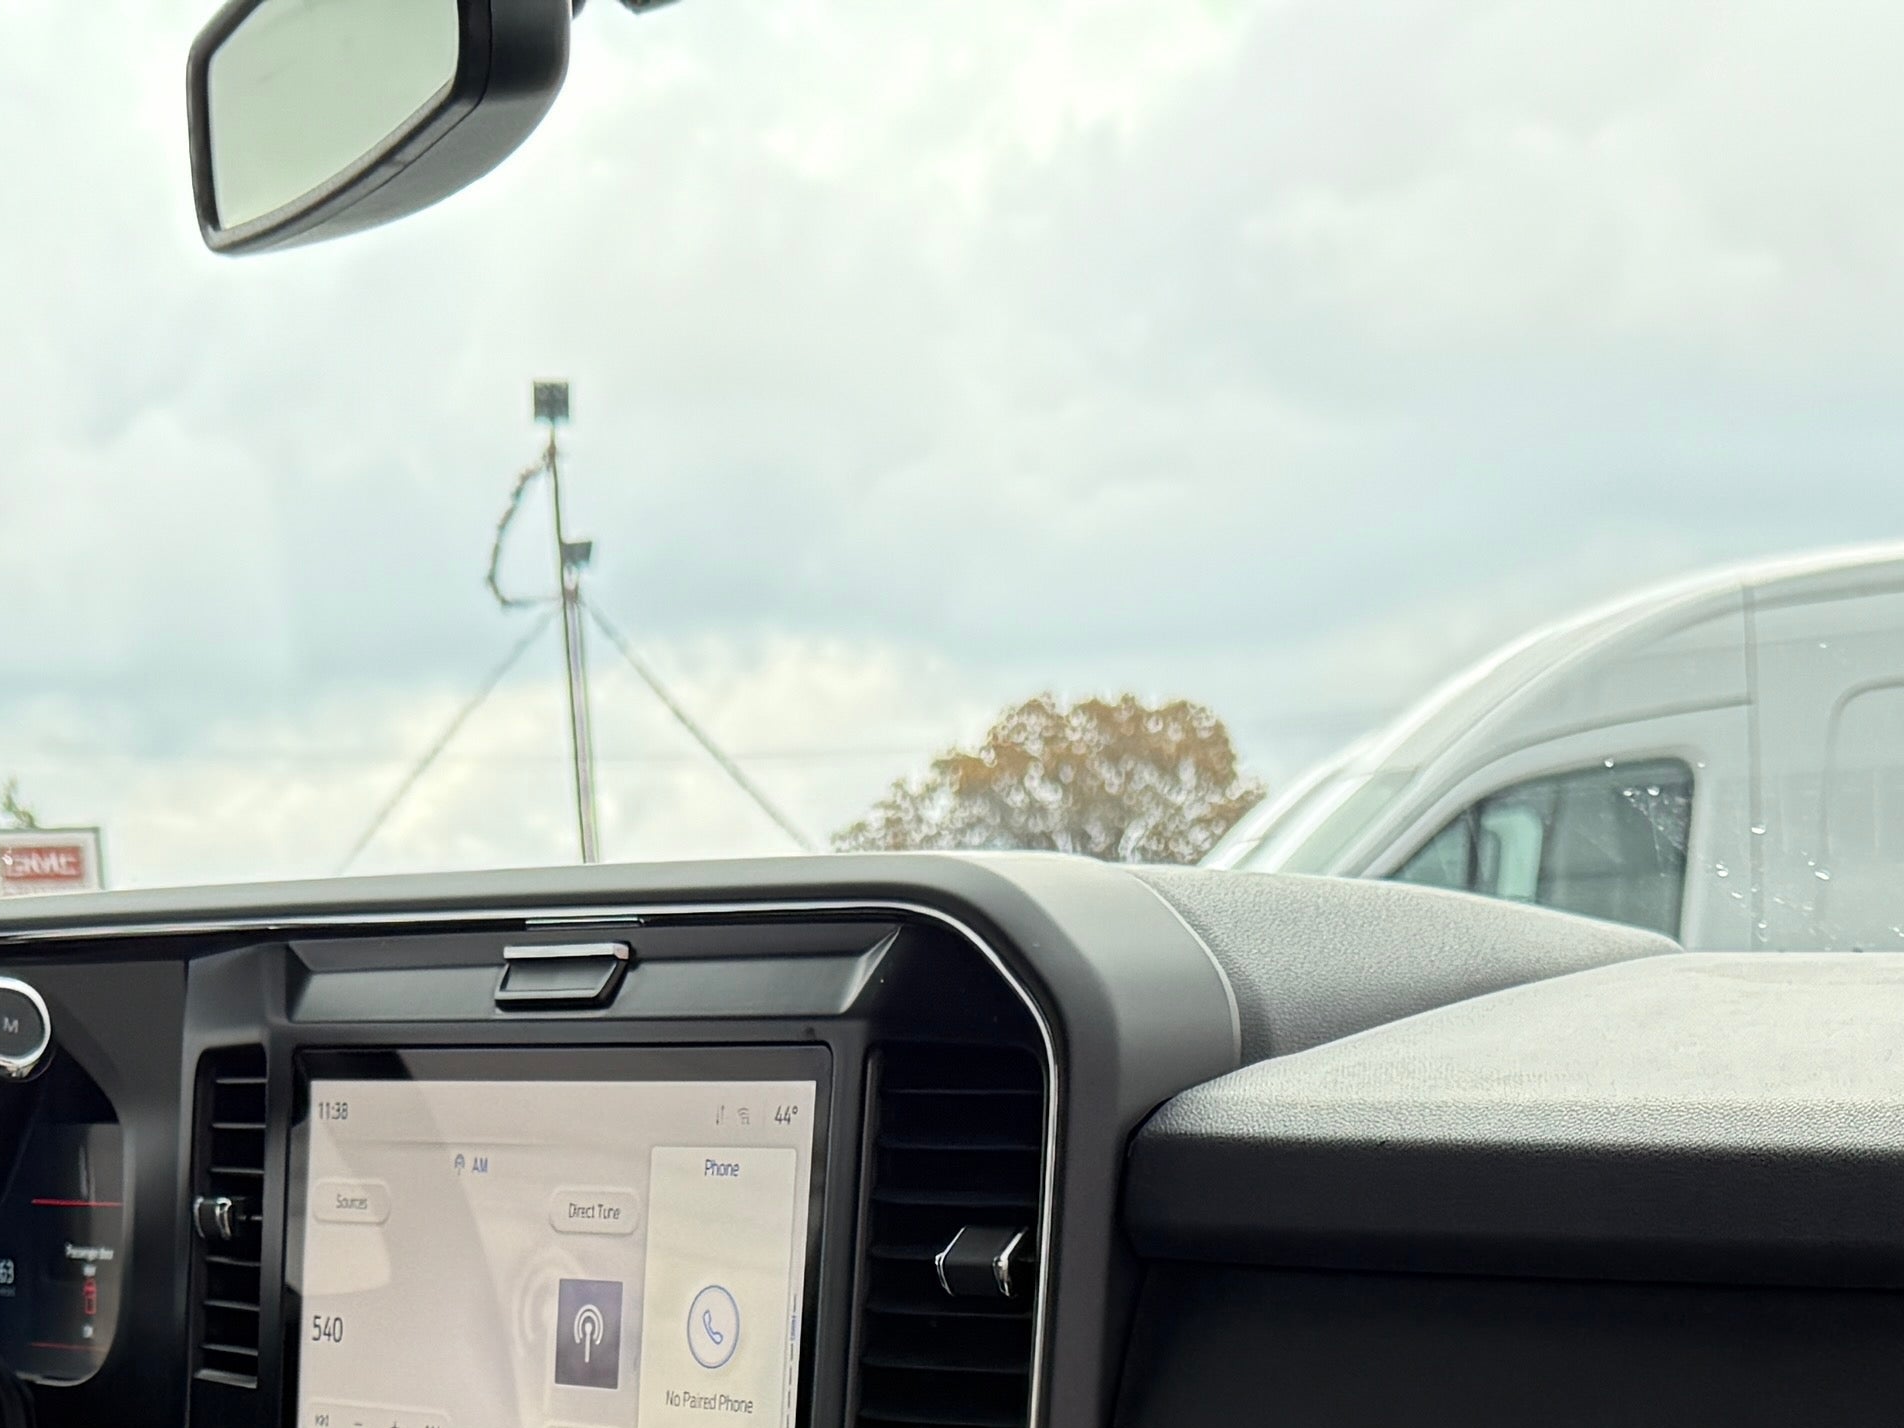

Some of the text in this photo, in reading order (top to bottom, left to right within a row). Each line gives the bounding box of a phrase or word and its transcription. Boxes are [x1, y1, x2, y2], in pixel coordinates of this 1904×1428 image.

[3, 1017, 20, 1034] M
[318, 1101, 349, 1120] 11:38
[471, 1156, 489, 1174] AM
[703, 1158, 740, 1178] Phone
[568, 1202, 622, 1221] Direct Tune
[311, 1315, 344, 1344] 540
[665, 1389, 754, 1415] No Paired Phone
